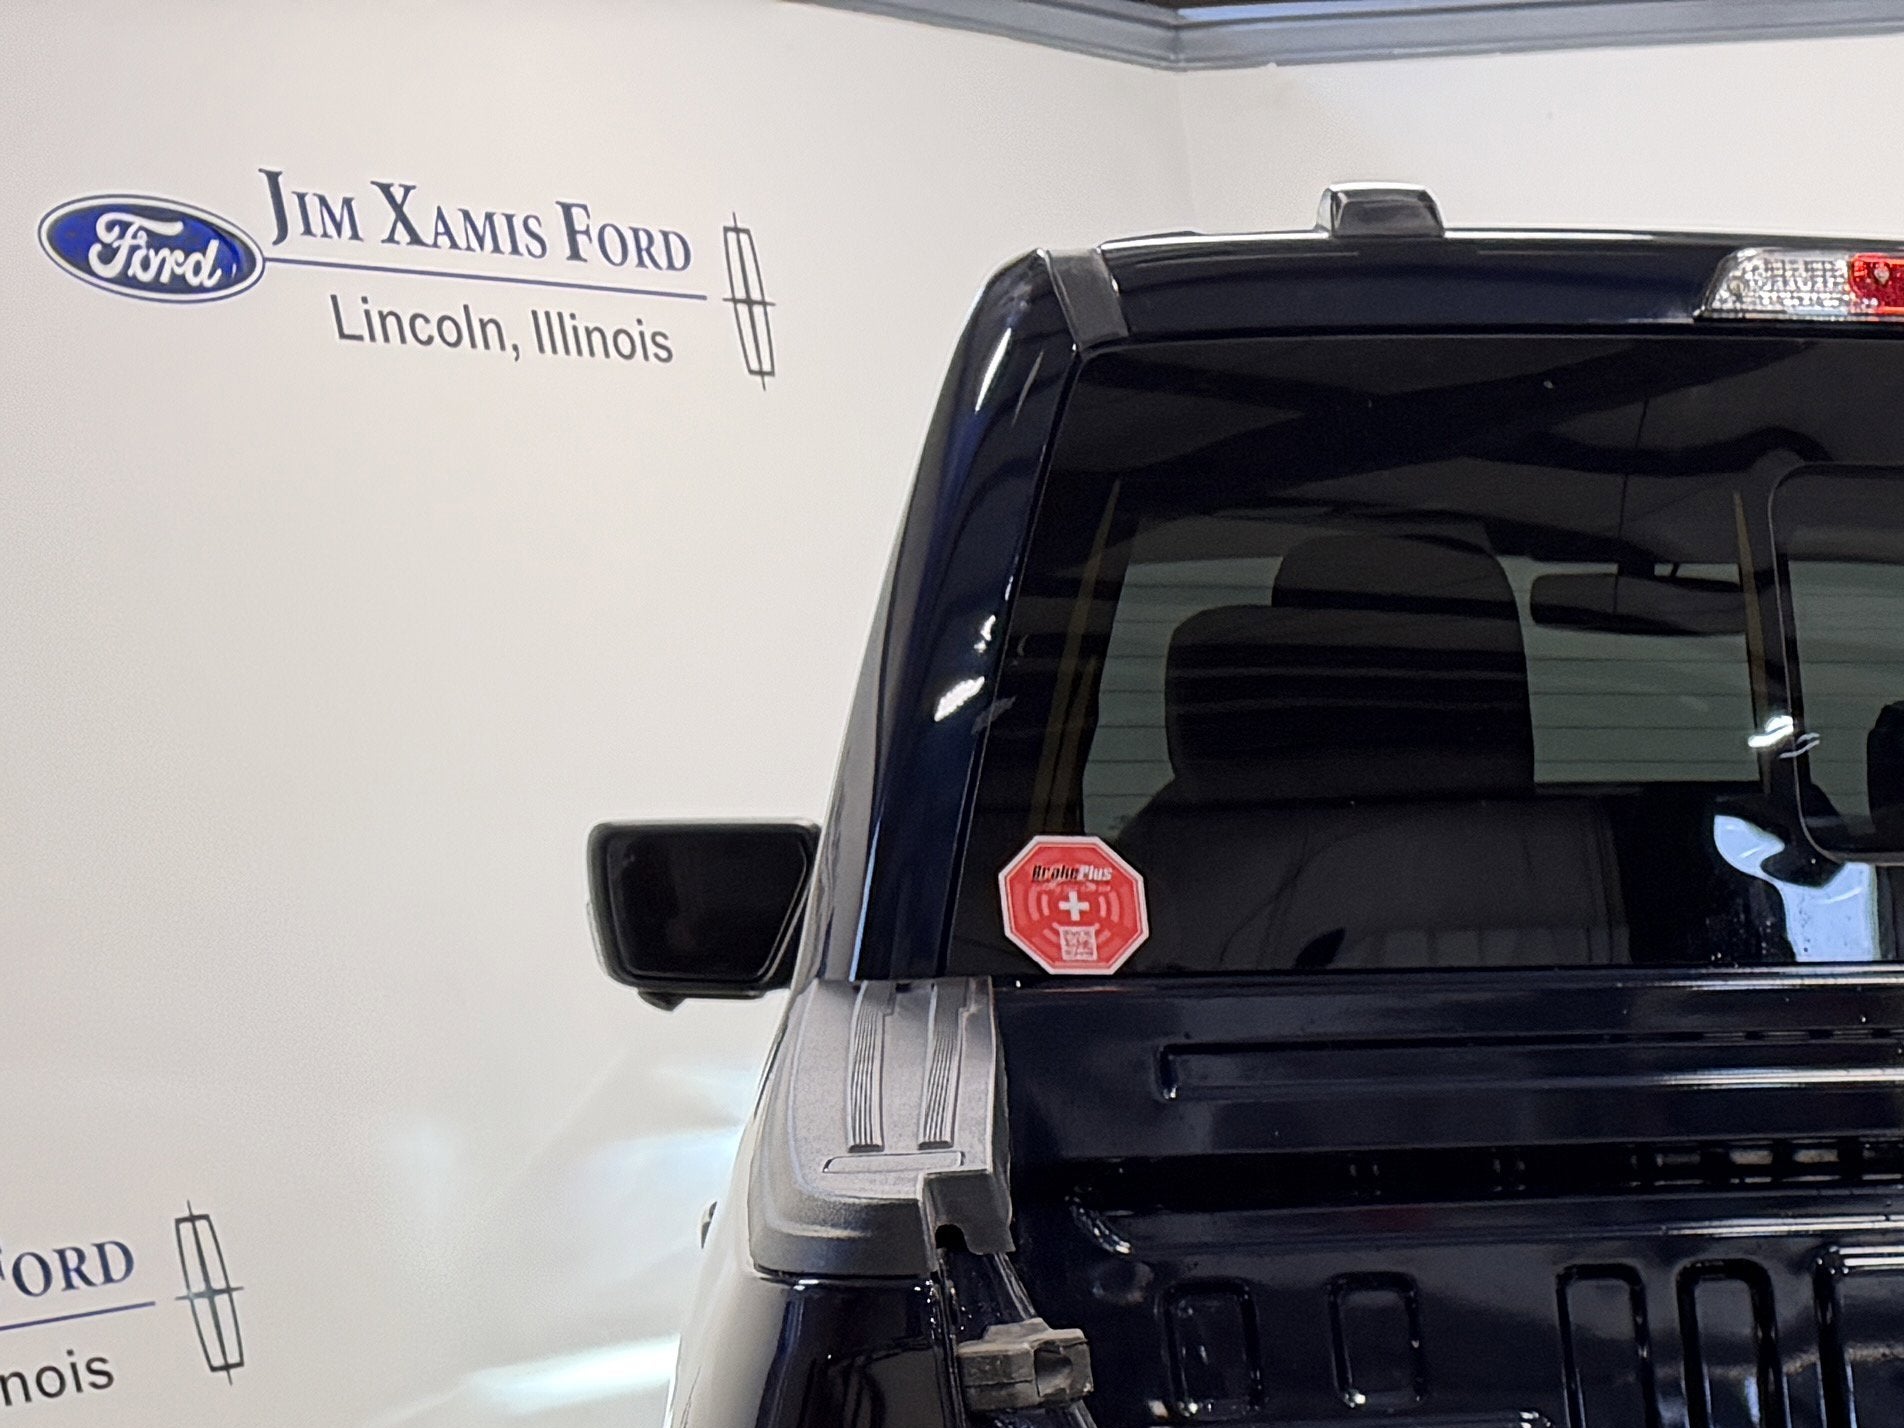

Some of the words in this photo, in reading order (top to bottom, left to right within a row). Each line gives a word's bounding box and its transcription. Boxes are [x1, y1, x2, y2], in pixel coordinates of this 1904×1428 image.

[88, 211, 222, 288] Ford
[258, 167, 364, 246] JIM
[370, 180, 548, 260] XAMIS
[555, 200, 692, 273] FORD
[330, 294, 520, 362] Lincoln,
[531, 309, 674, 364] Illinois
[0, 1240, 135, 1298] ORD
